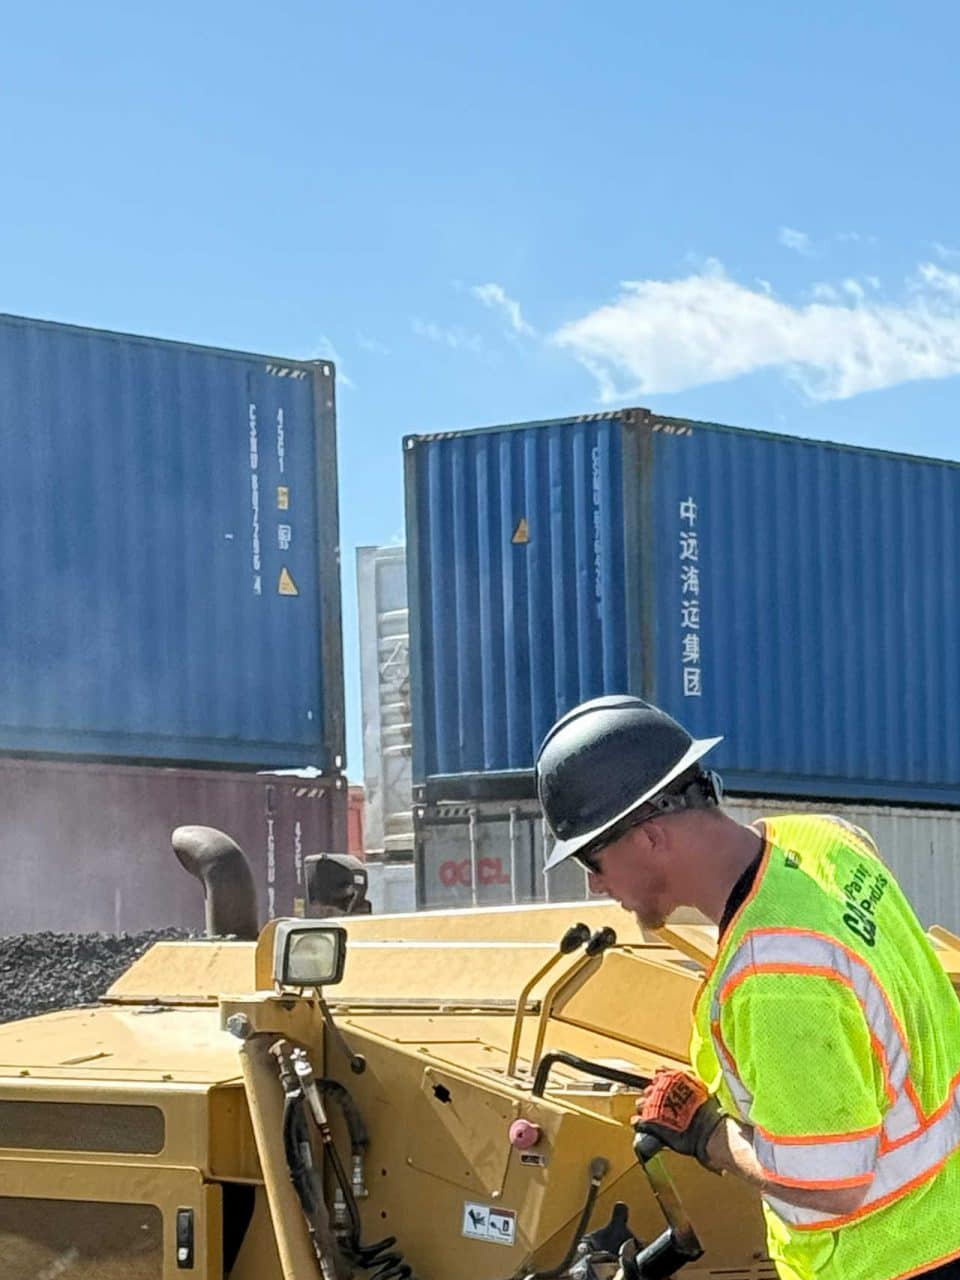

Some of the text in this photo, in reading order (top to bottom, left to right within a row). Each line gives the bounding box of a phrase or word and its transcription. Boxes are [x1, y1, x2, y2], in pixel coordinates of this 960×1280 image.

[679, 496, 702, 697] 中远海运集团
[439, 857, 511, 888] OOCL
